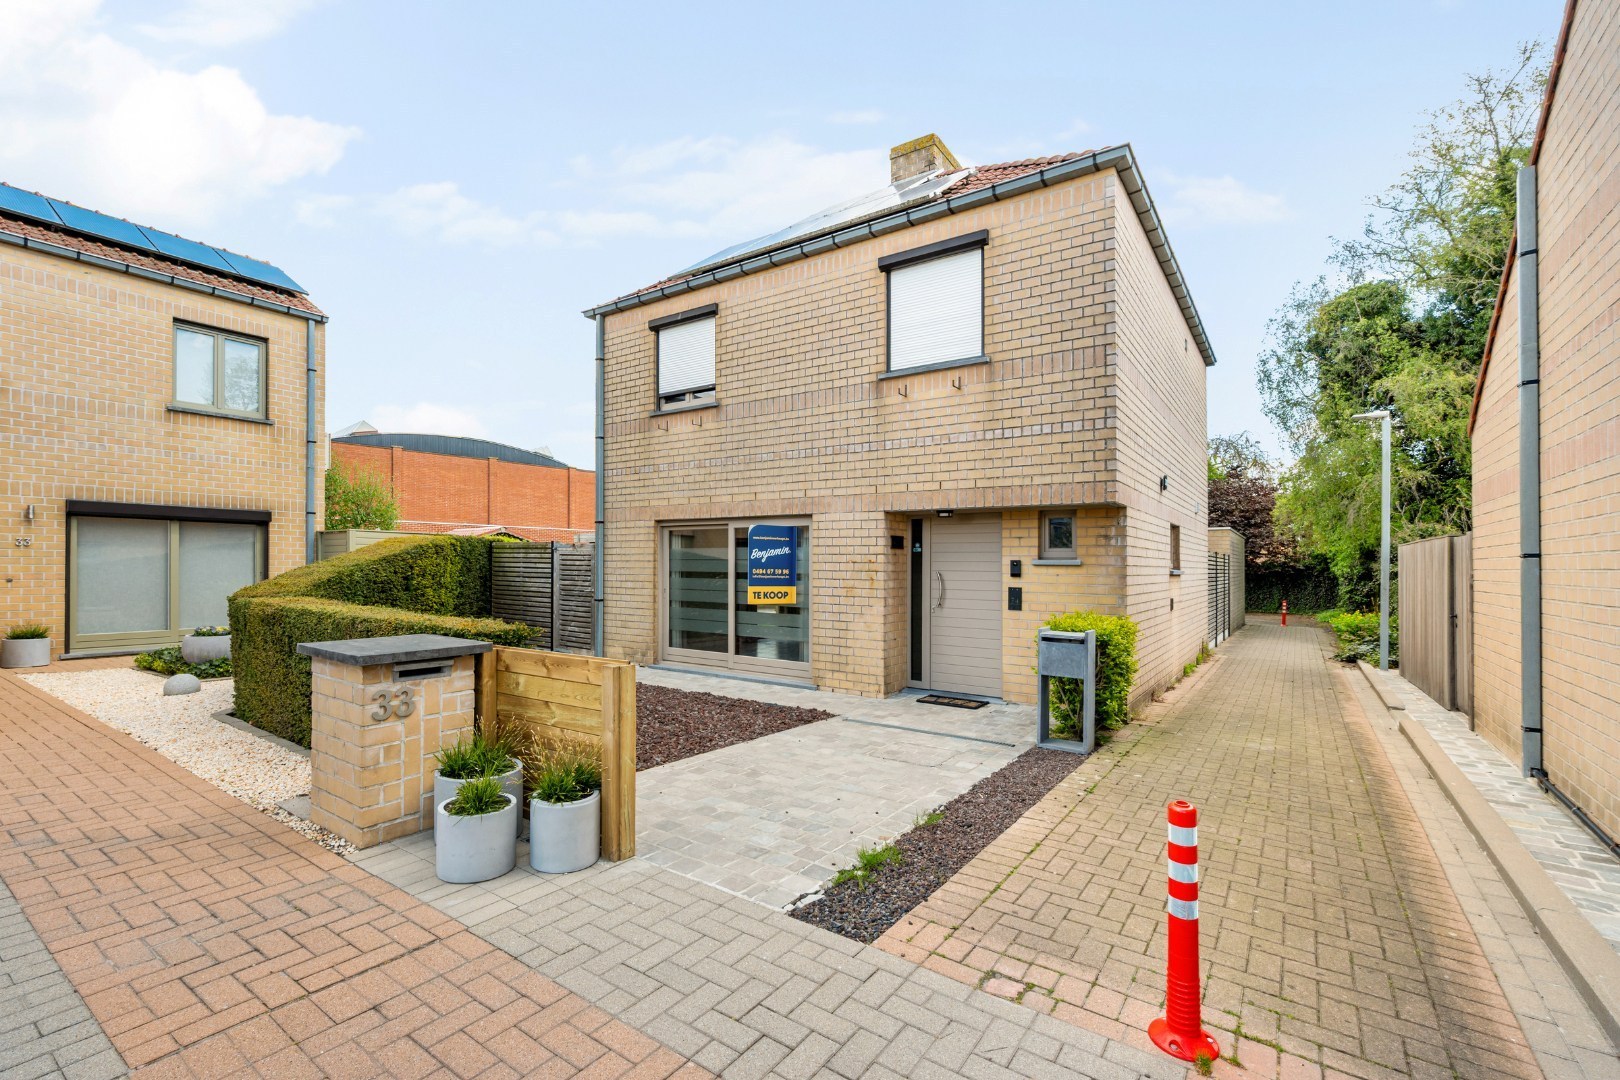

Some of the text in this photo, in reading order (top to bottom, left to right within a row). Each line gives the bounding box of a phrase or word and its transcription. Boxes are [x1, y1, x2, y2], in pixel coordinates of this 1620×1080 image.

[15, 537, 31, 547] 33
[752, 591, 789, 599] TE KOOP
[371, 686, 416, 721] 33
